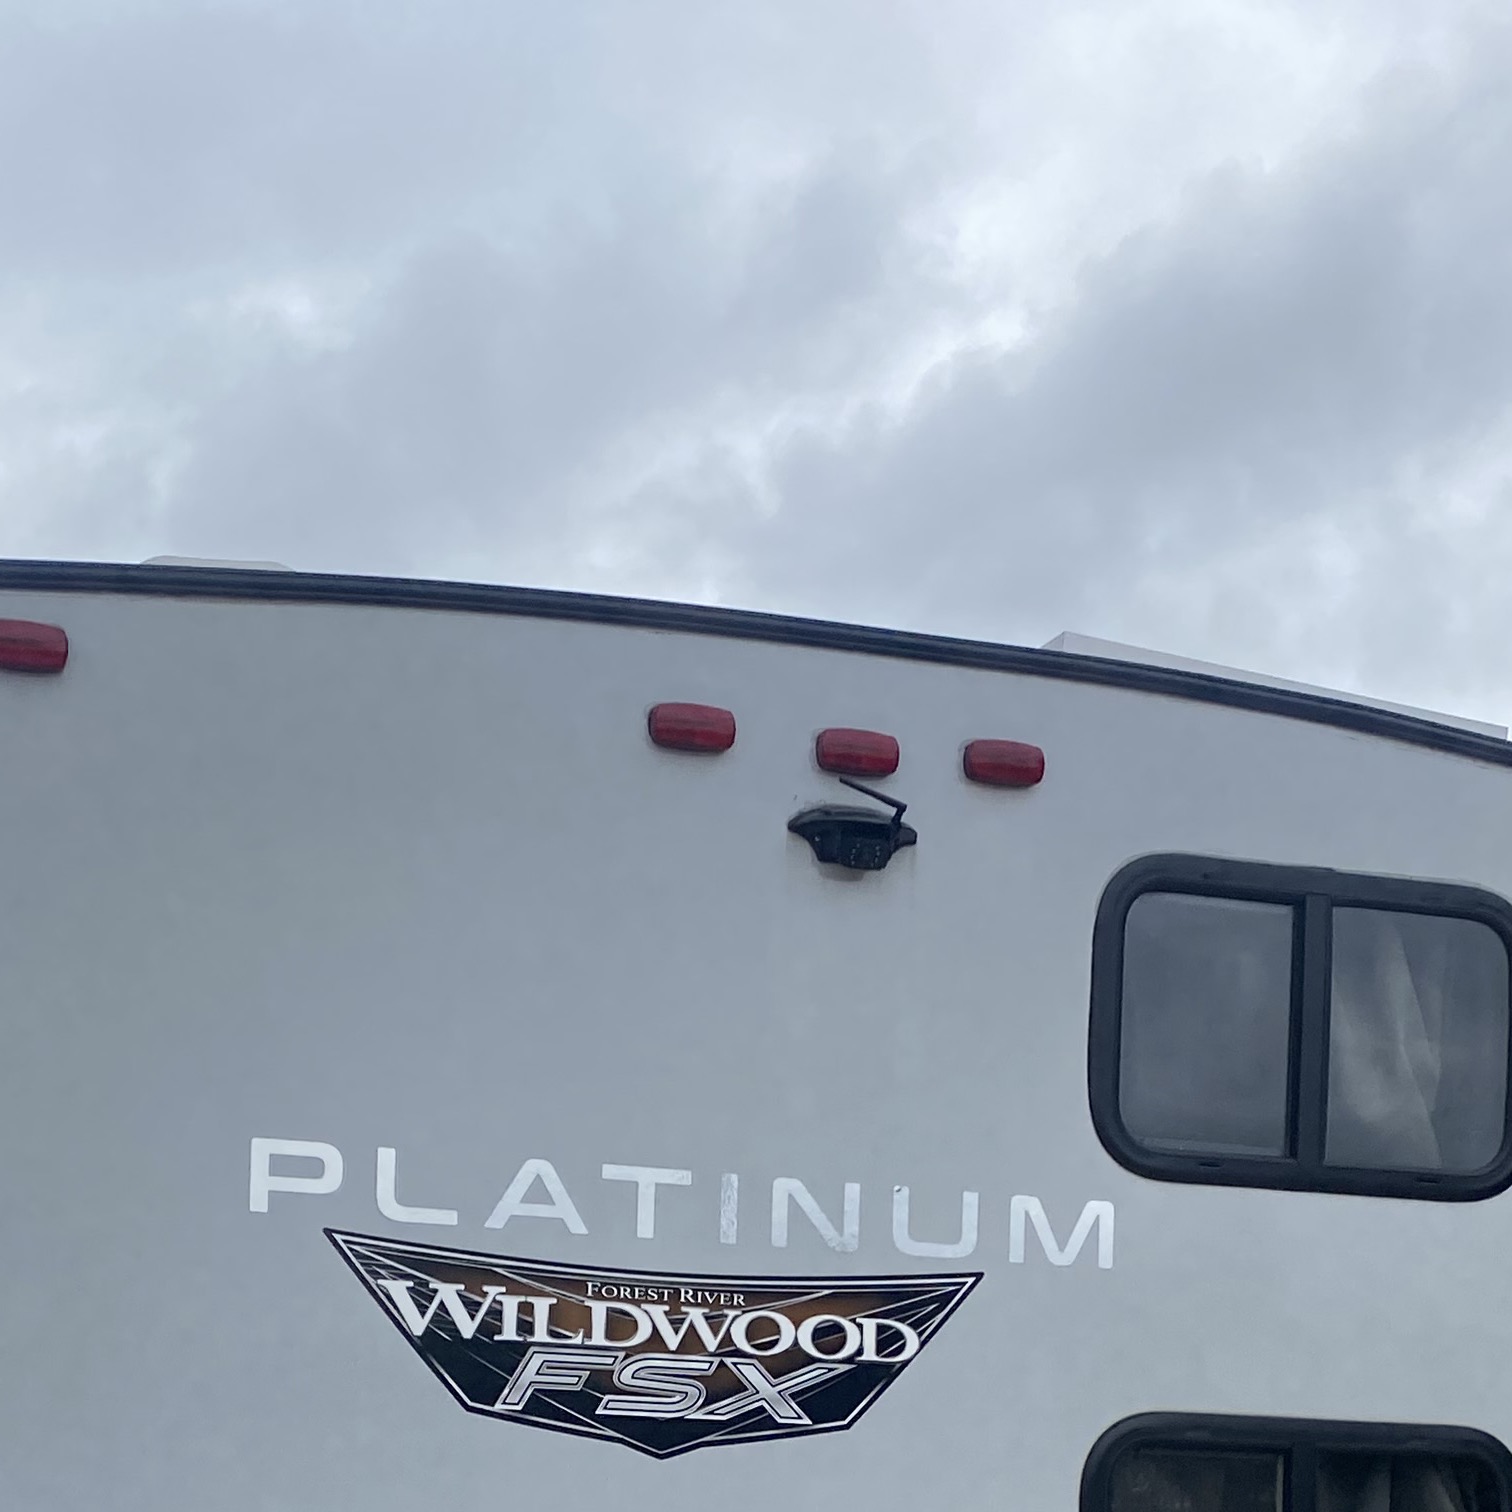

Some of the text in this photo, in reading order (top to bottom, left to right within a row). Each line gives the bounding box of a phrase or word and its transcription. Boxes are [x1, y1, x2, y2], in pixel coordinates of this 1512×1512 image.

[248, 1136, 1115, 1270] PLATINUM
[377, 1279, 921, 1363] WILDWOOD
[585, 1280, 746, 1307] FOREST RIVER
[492, 1346, 860, 1425] FSX
